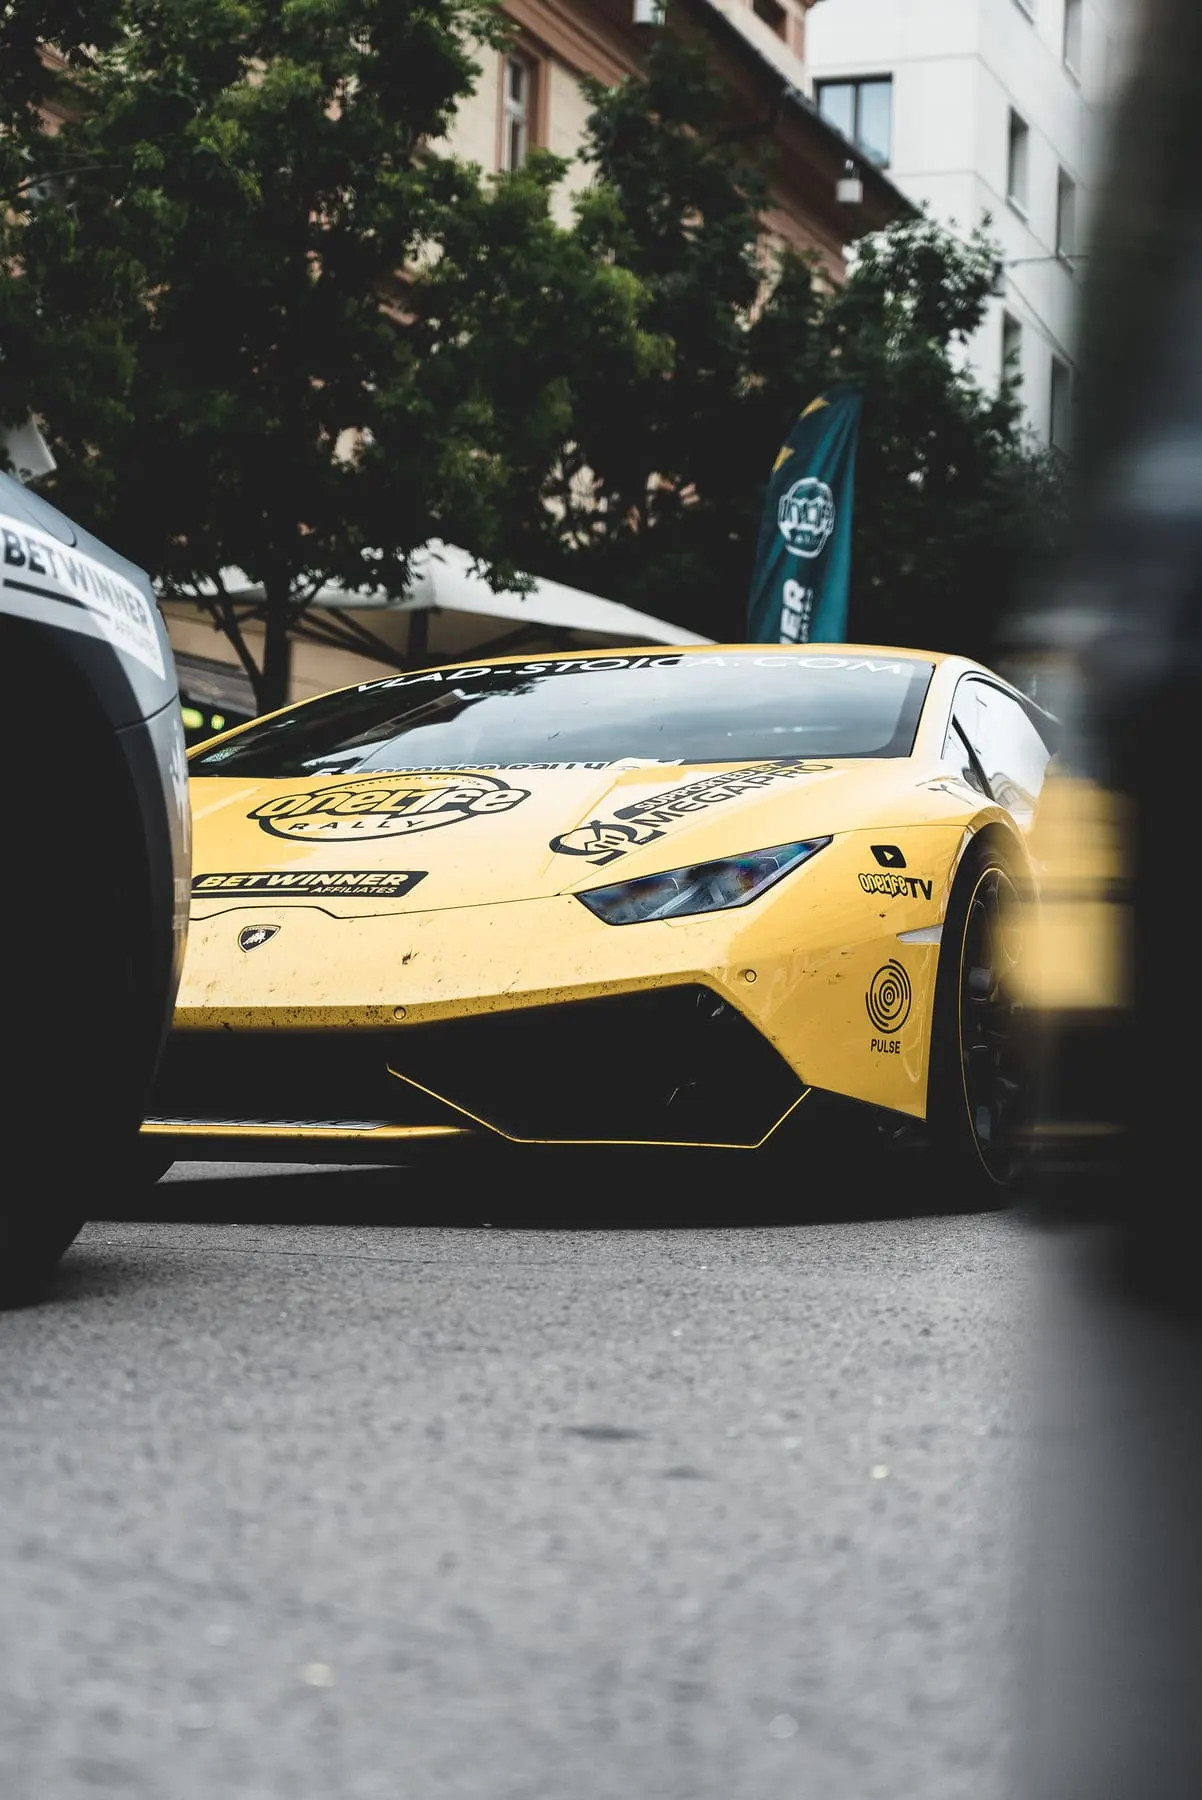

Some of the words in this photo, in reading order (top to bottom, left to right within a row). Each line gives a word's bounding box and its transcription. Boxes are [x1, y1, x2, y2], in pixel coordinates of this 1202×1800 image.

[2, 528, 151, 634] BETWINNER
[358, 656, 901, 692] VLAD-STOICA.COM
[634, 767, 756, 810] SUPPORTED
[287, 819, 427, 831] RALLY
[196, 873, 409, 888] BETWINNER
[308, 886, 398, 895] AFFILIATES
[870, 1038, 901, 1054] PULSE
